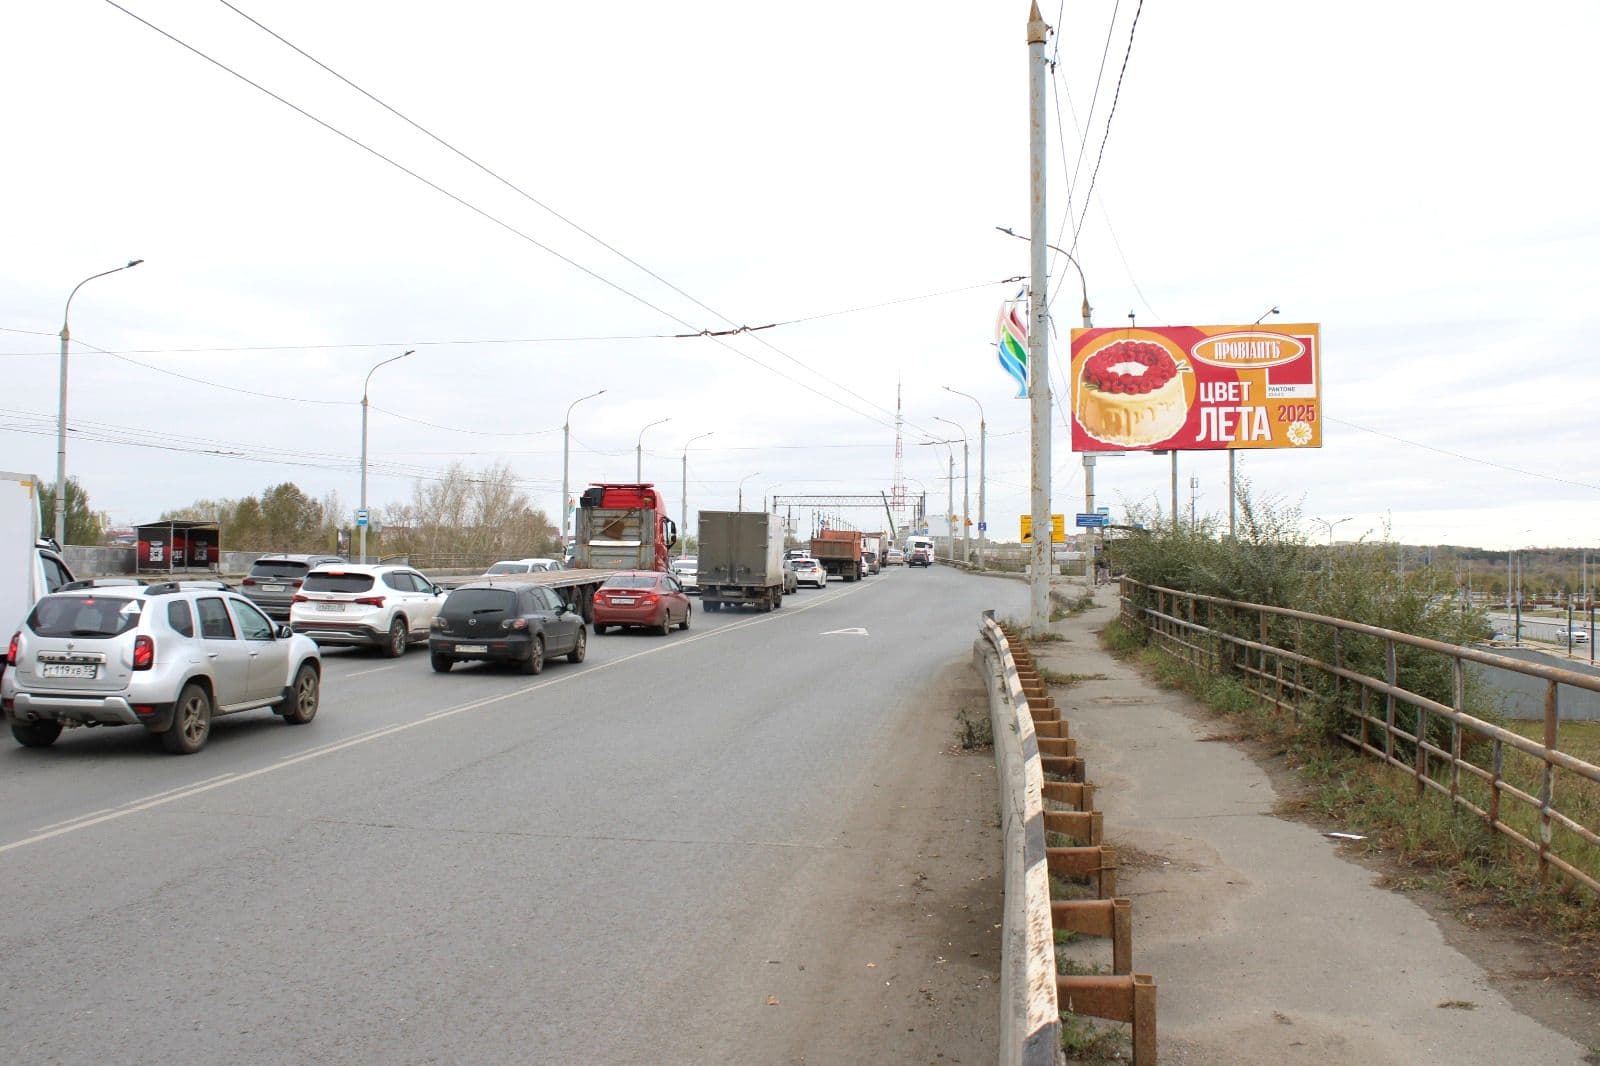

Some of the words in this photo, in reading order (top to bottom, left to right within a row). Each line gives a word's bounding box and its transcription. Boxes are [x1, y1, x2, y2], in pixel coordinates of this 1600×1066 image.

[1200, 382, 1252, 403] ЦВЕТ
[1278, 404, 1316, 422] 2025
[1195, 406, 1272, 443] ЛЕТА
